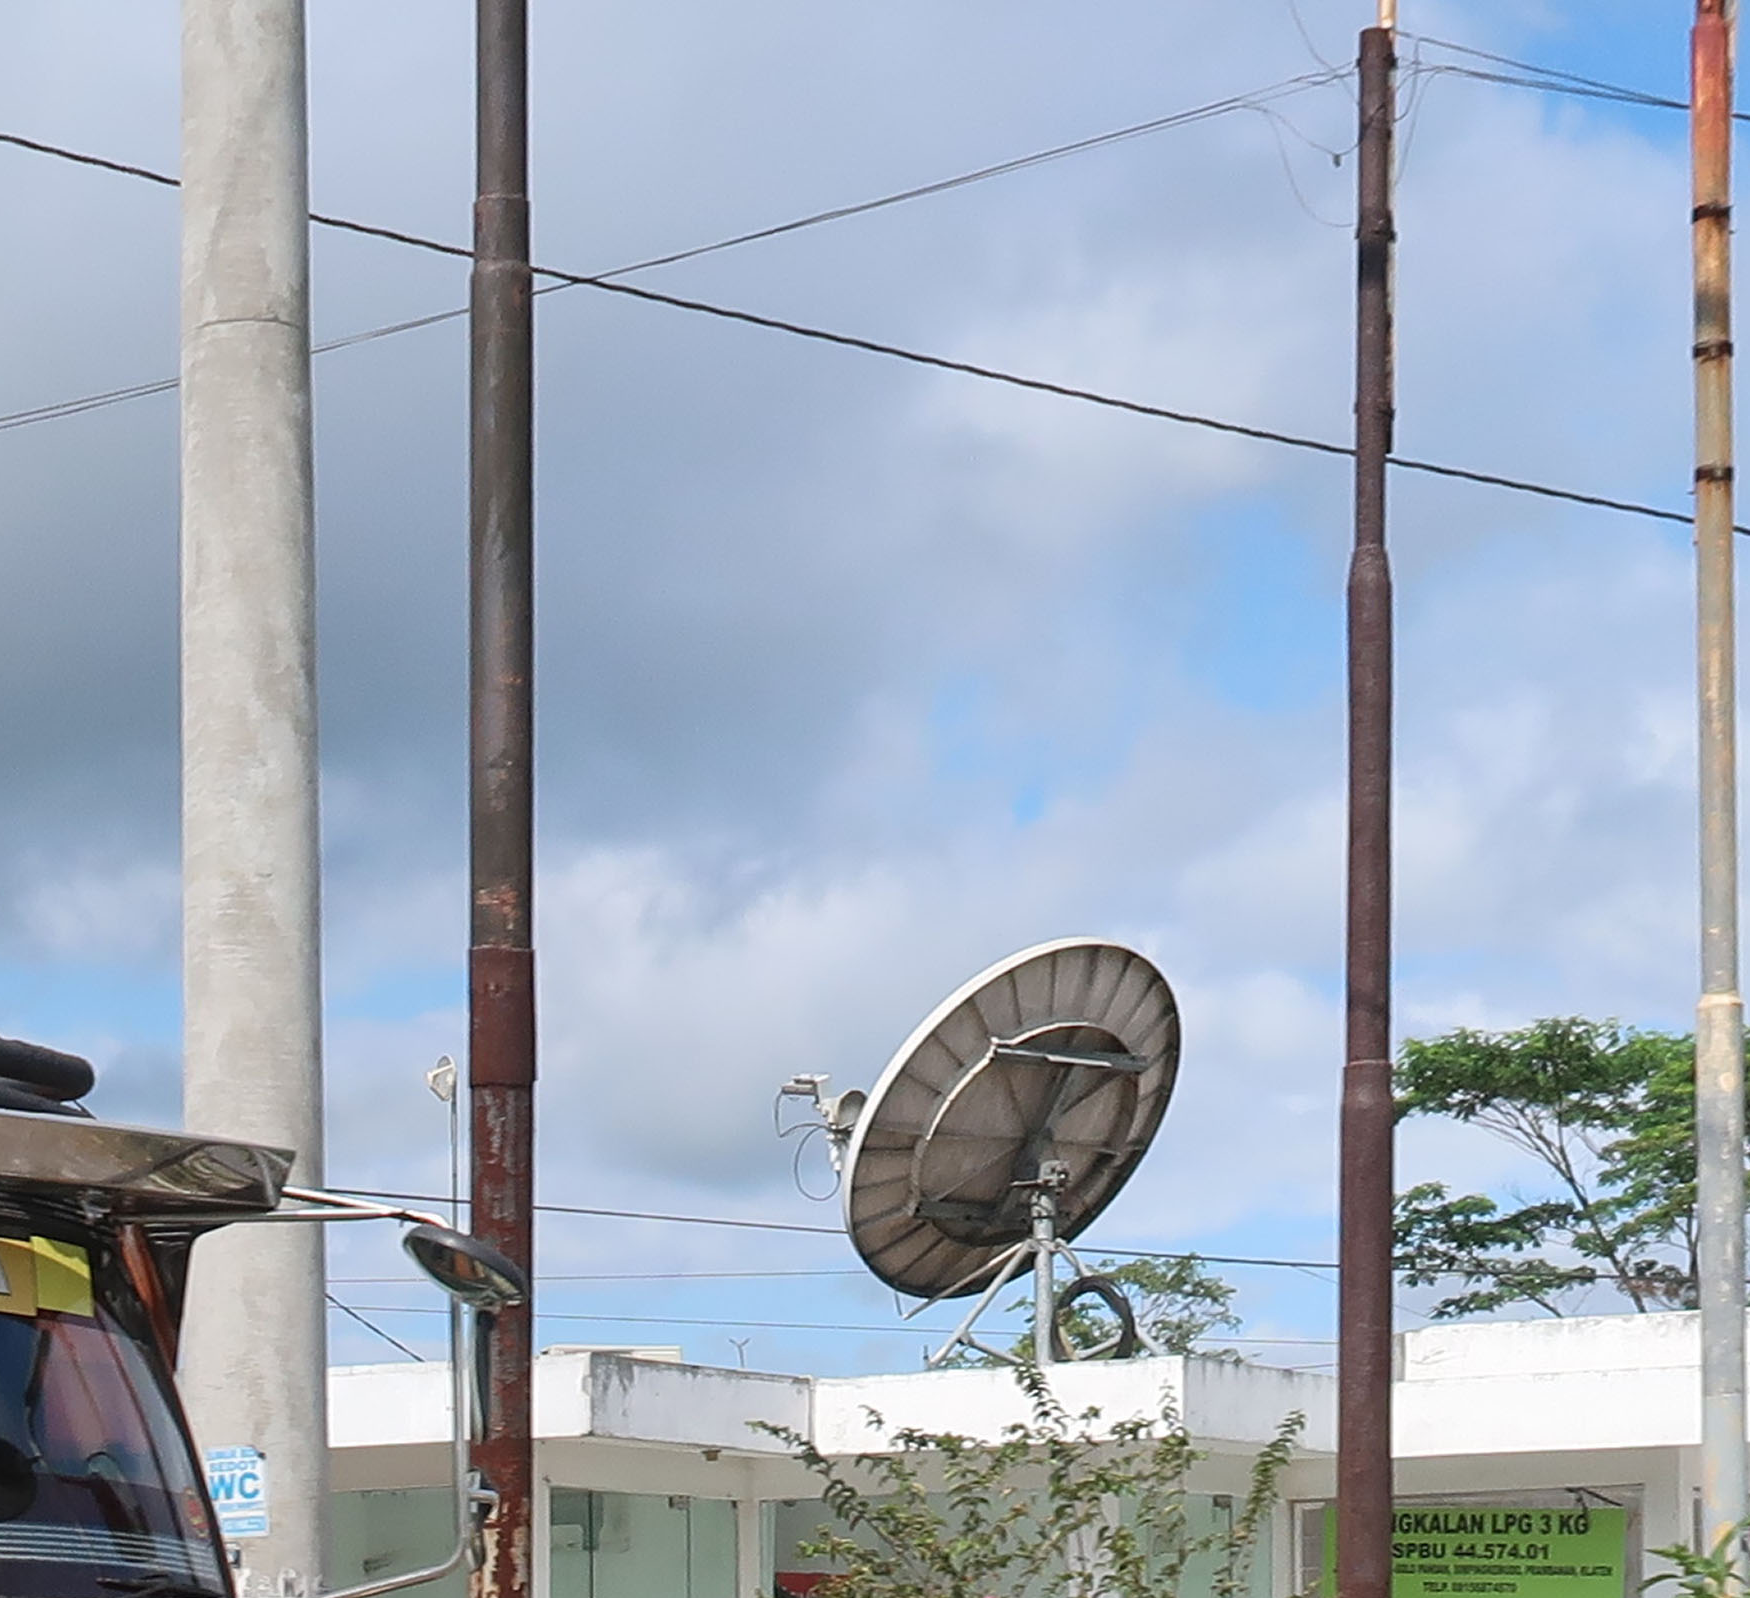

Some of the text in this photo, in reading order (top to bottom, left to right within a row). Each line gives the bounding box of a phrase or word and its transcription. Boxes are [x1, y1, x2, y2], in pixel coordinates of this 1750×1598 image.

[208, 1471, 260, 1500] WC
[1491, 1513, 1533, 1535] LPG
[1539, 1514, 1552, 1535] 3
[1558, 1514, 1590, 1535] KG
[1391, 1543, 1446, 1559] SPBU
